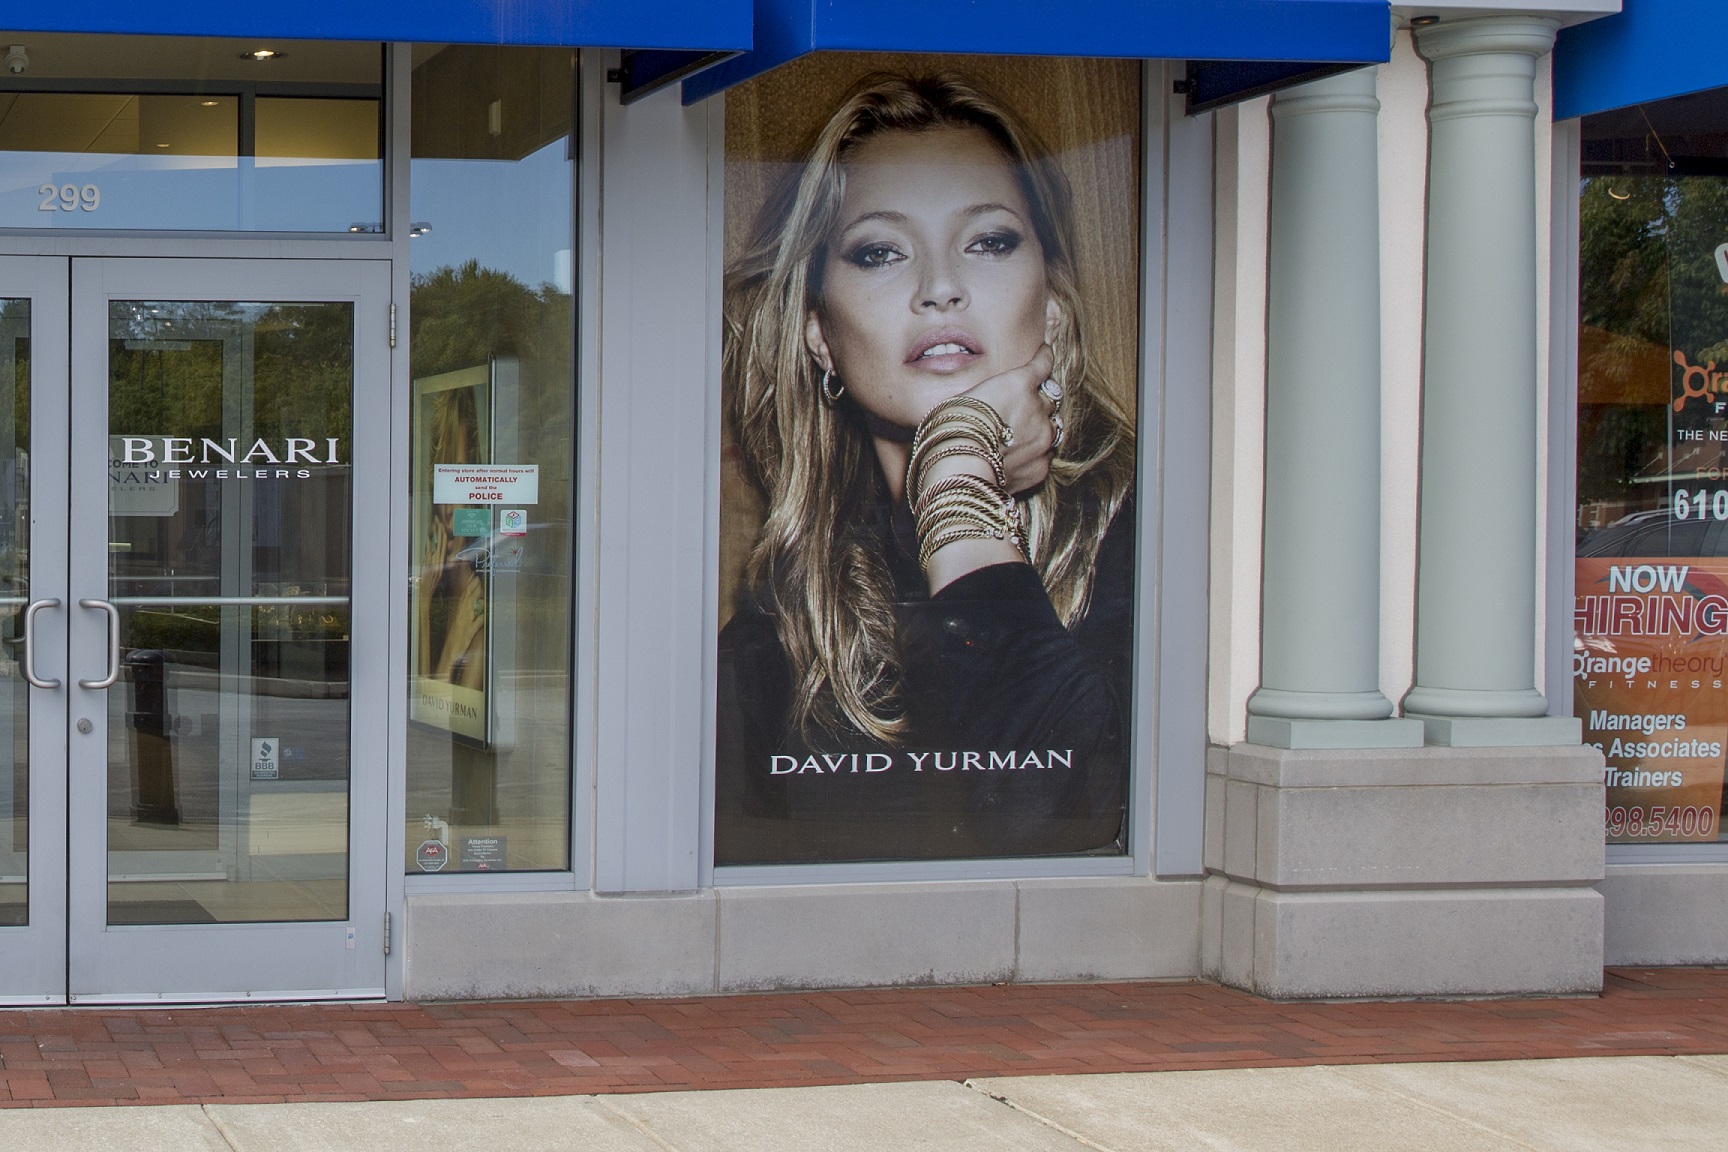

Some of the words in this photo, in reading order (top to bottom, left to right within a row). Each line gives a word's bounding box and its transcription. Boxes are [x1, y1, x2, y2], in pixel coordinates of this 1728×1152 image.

[38, 183, 100, 212] 299
[1677, 430, 1703, 441] THE
[122, 438, 339, 463] BENARI
[149, 469, 312, 479] JEWELERS
[1609, 565, 1689, 593] NOW
[1588, 680, 1721, 689] FITNESS
[423, 694, 444, 710] DAVID
[445, 700, 477, 720] YURMAN
[1590, 710, 1686, 736] Managers
[1608, 737, 1721, 758] Associates
[770, 753, 892, 775] DAVID
[907, 749, 1073, 772] YURMAN
[1605, 767, 1683, 787] Trainers
